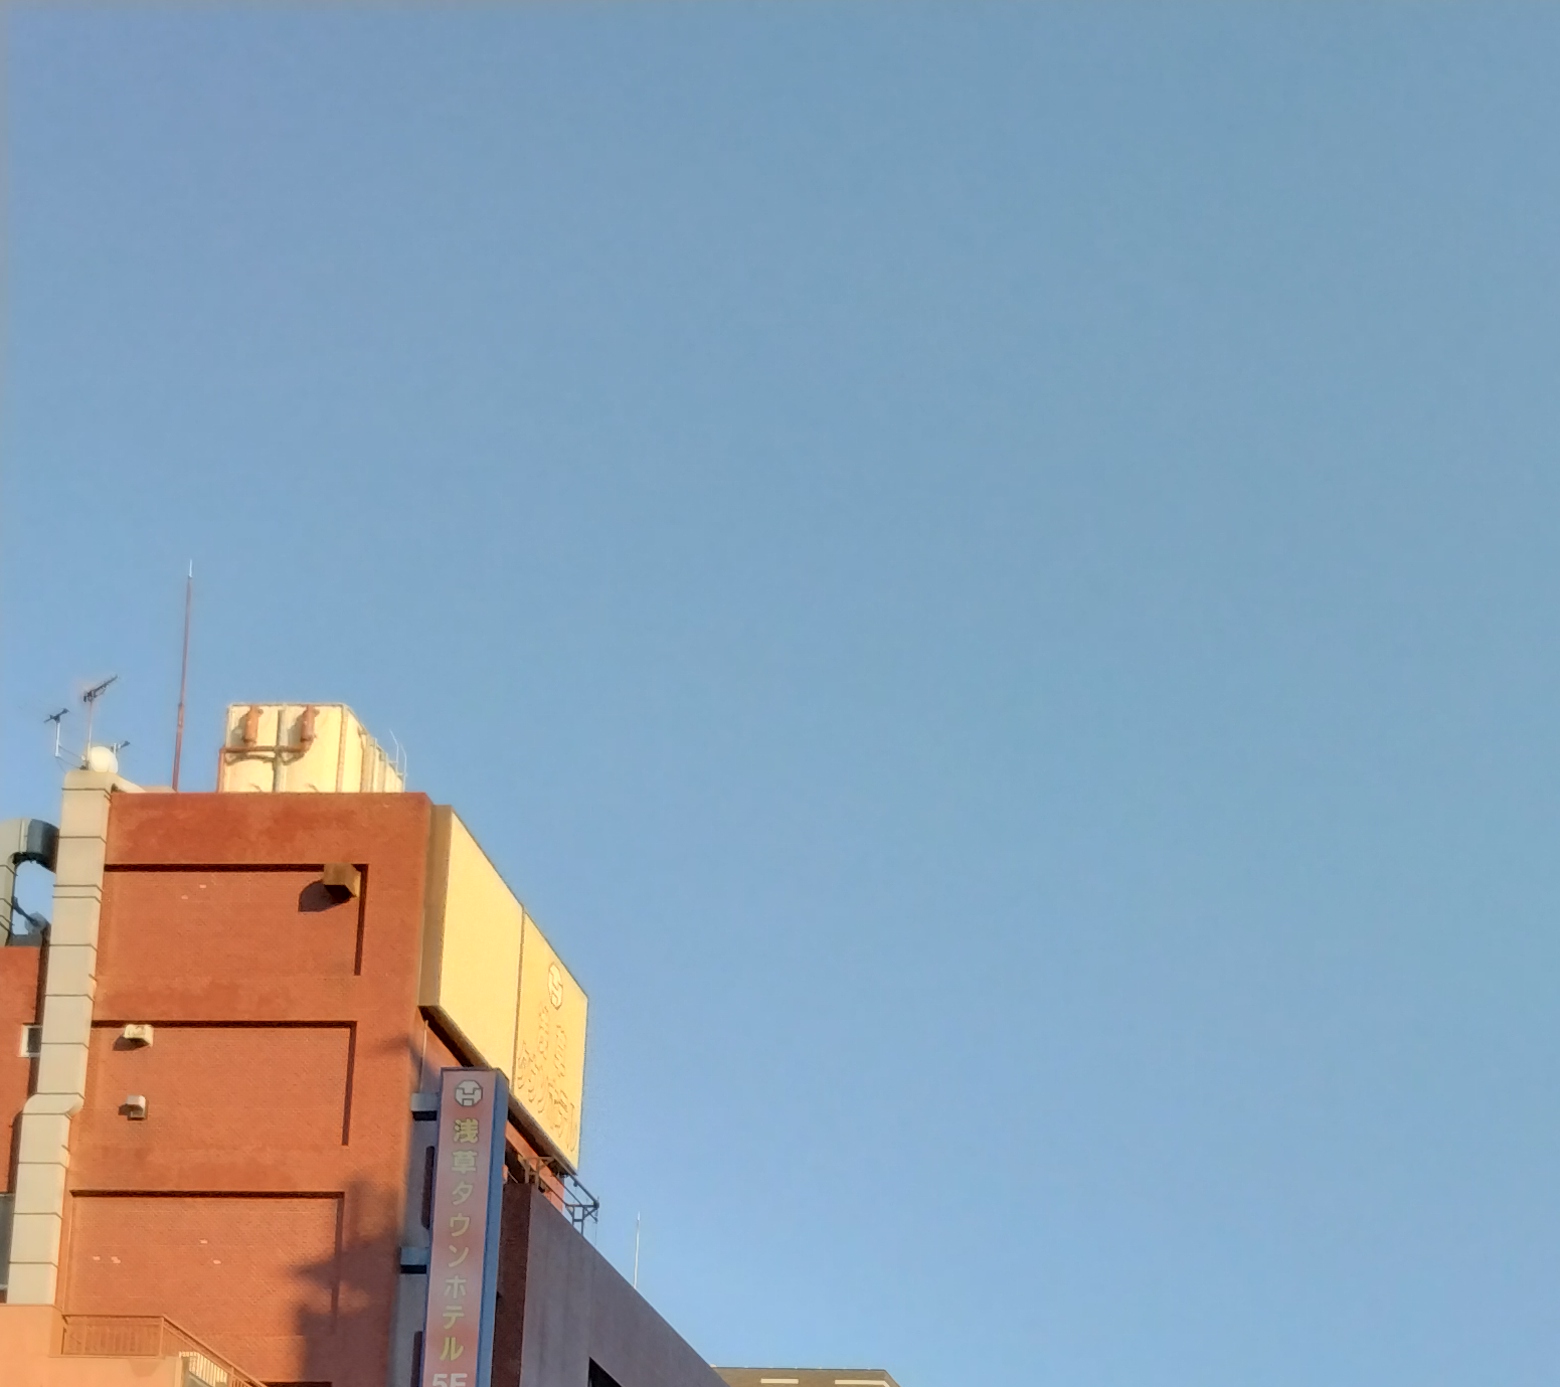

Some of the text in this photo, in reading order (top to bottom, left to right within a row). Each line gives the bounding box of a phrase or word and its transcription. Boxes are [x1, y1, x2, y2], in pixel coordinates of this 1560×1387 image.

[439, 1117, 480, 1362] 浅草タウンホテル
